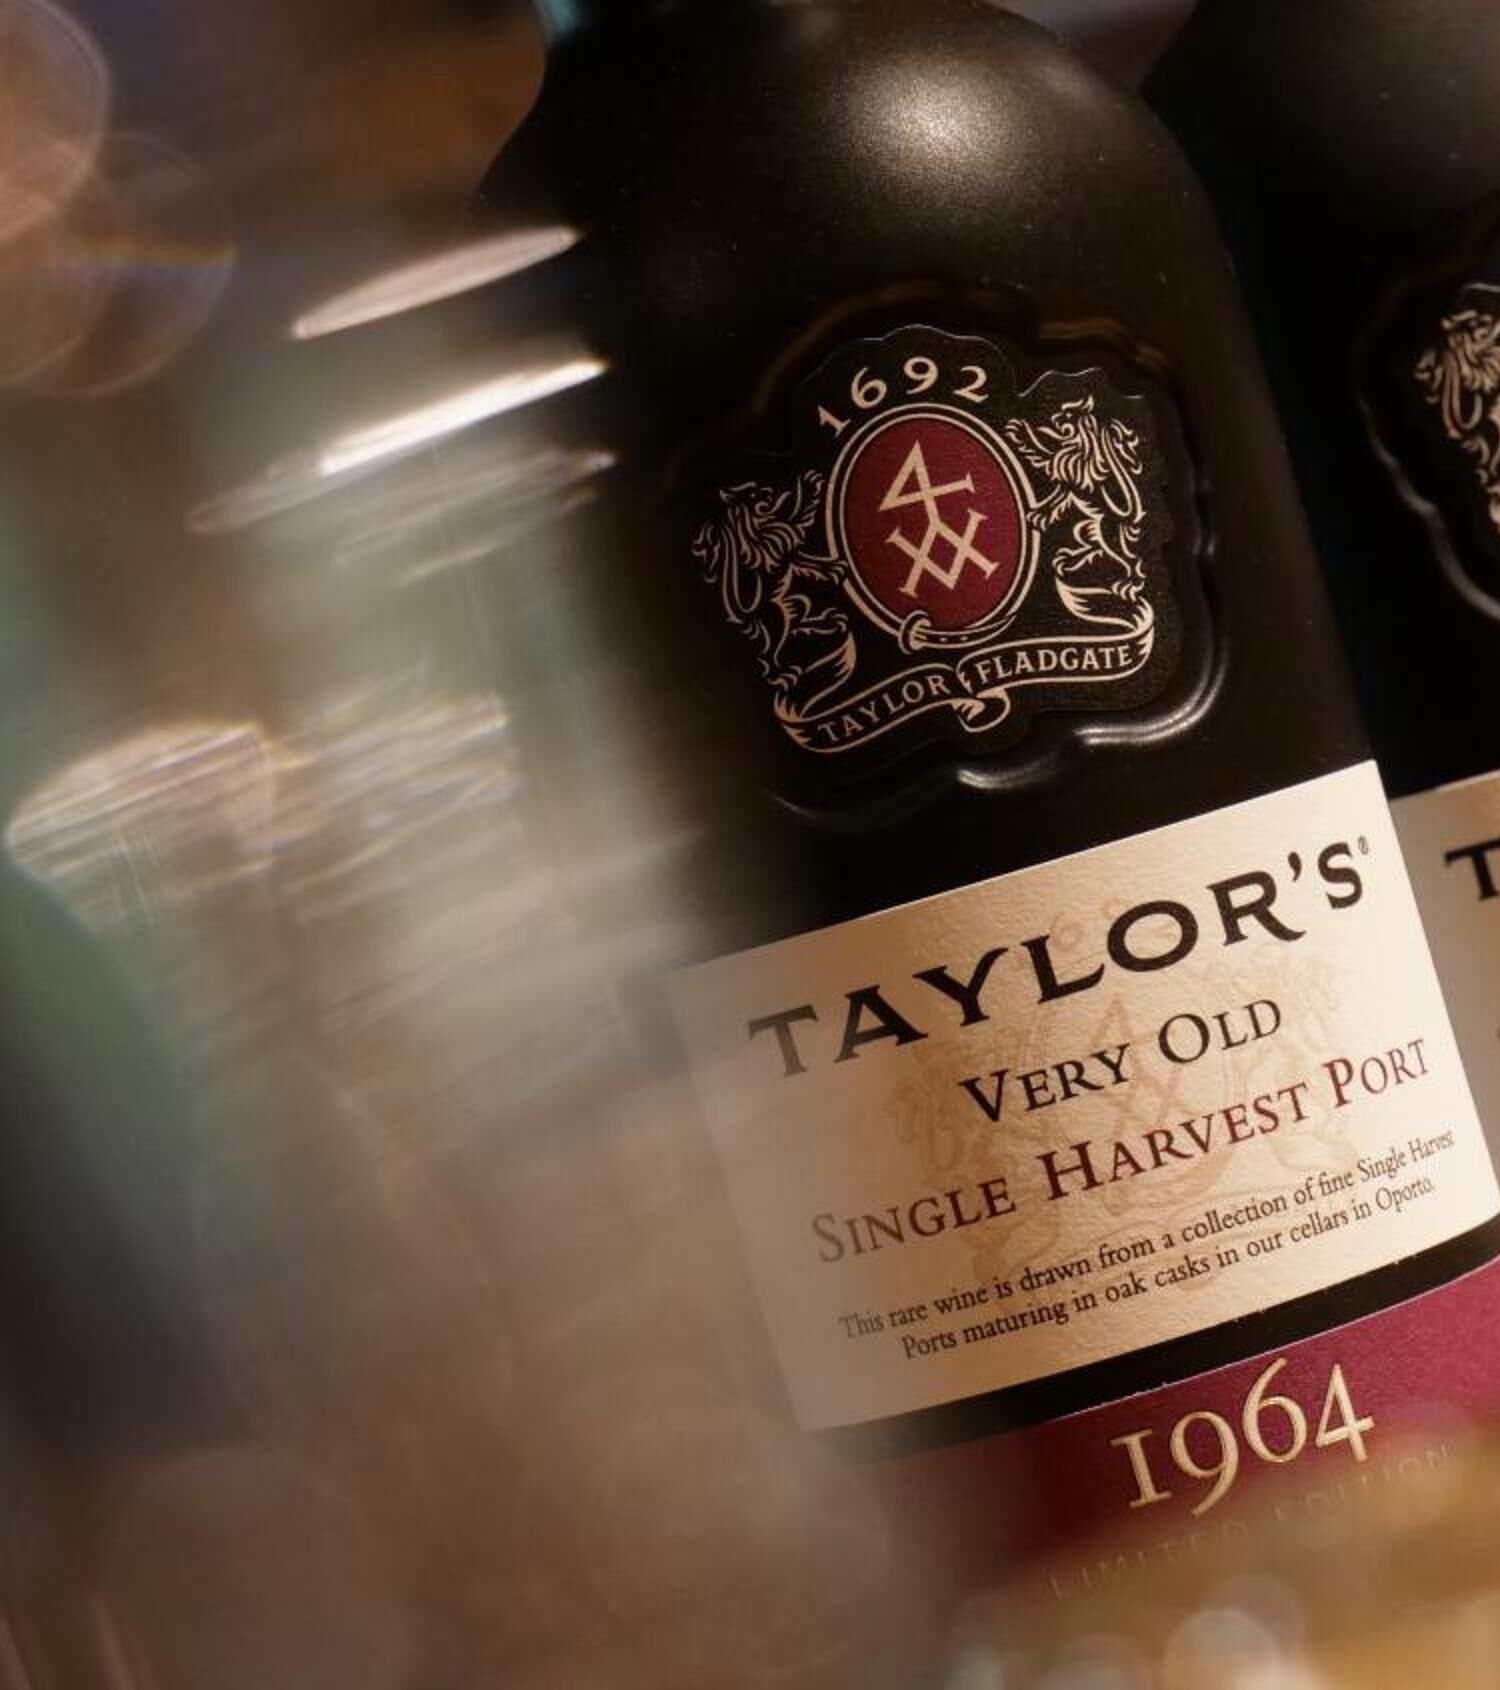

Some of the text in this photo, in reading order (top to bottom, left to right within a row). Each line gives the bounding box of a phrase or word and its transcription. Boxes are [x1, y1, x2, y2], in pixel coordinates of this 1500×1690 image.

[818, 356, 989, 437] 1692
[818, 645, 1133, 742] TAYLOR FLADGATE
[748, 841, 1363, 1078] TAYLOR'S
[838, 1129, 1456, 1340] This rare wine is drawn from a collection of fine Single Harvest
[901, 1330, 958, 1360] Ports
[963, 1301, 1070, 1345] maturing
[1072, 1289, 1099, 1313] in
[1105, 1271, 1149, 1303] oak
[1155, 1255, 1212, 1287] casks
[1216, 1245, 1240, 1269] in
[1247, 1233, 1283, 1258] our
[1290, 1209, 1350, 1244] cellars
[1353, 1200, 1373, 1221] in
[1109, 1357, 1376, 1516] 1964
